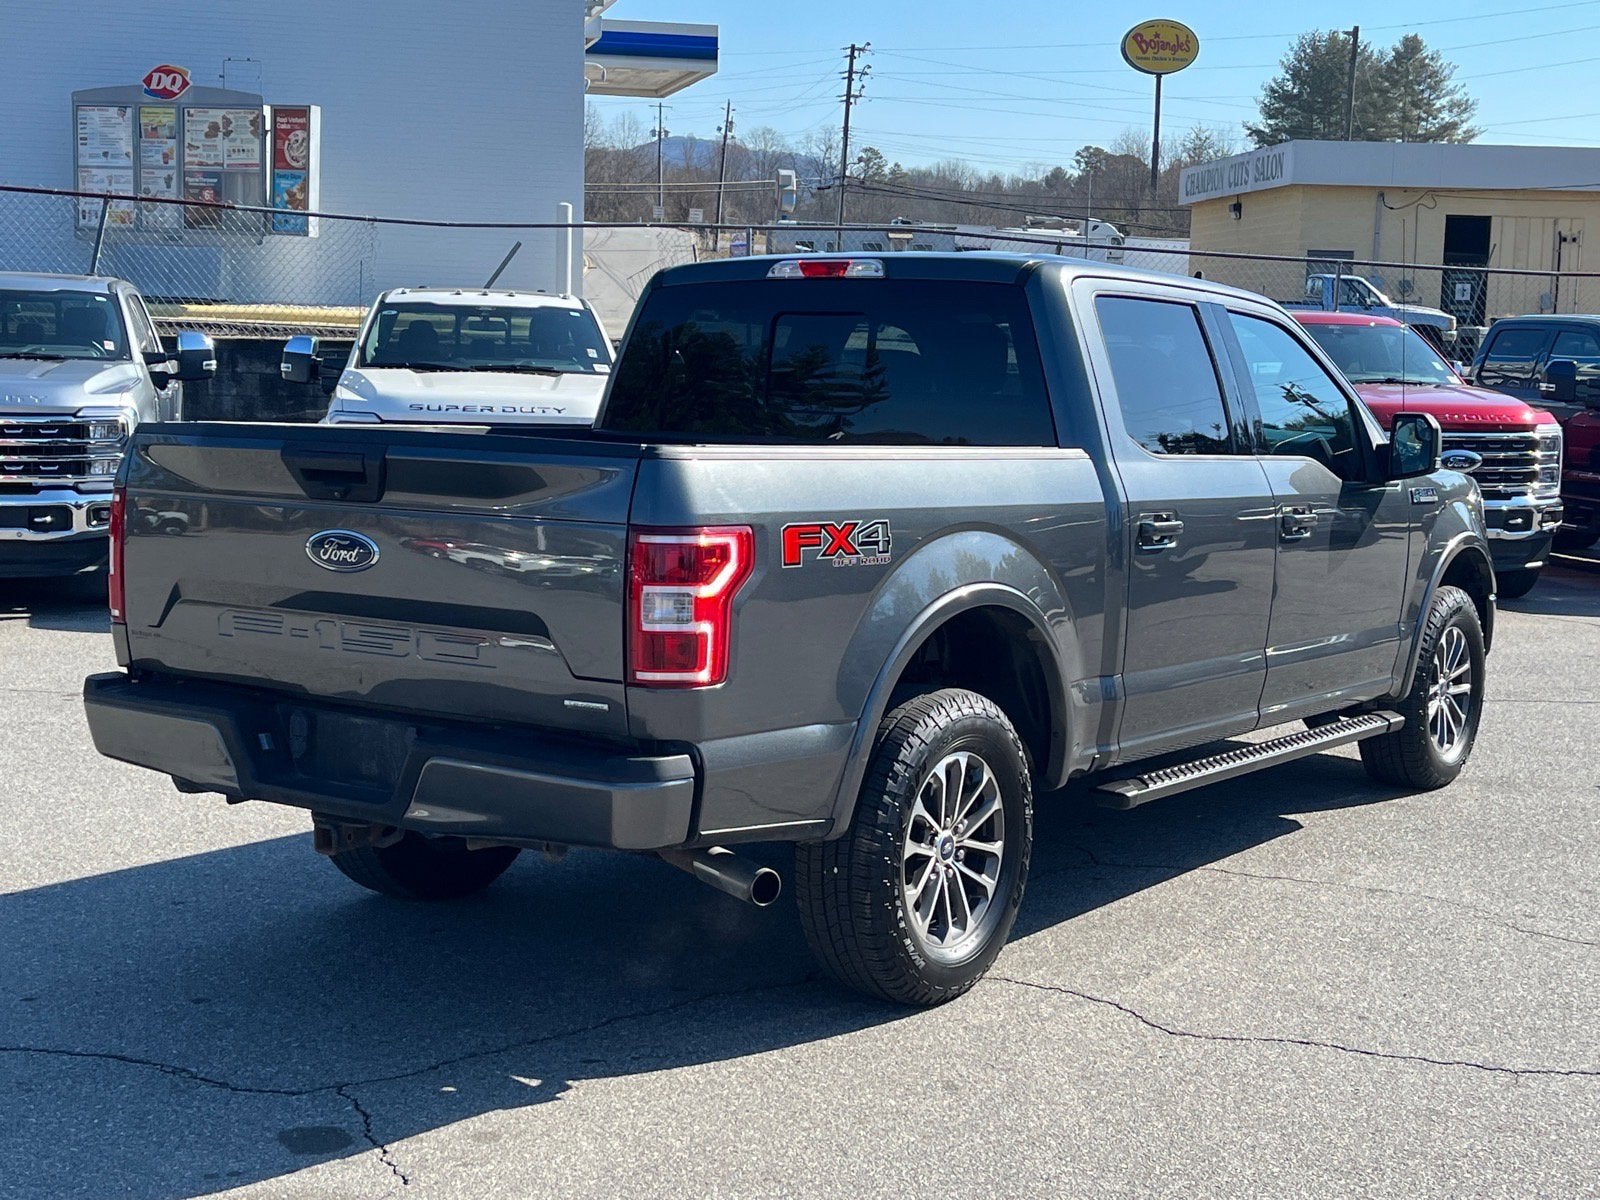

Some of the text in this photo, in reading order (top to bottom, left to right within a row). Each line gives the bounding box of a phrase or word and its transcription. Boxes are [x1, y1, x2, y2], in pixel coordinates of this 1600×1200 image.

[150, 72, 182, 93] DQ
[1185, 151, 1285, 197] CHAMPION CUTS SALON
[408, 403, 567, 414] SUPER DUTY
[319, 537, 360, 563] Ford
[781, 519, 892, 569] FX4
[832, 555, 892, 568] OFF ROAD
[218, 608, 497, 669] F-150
